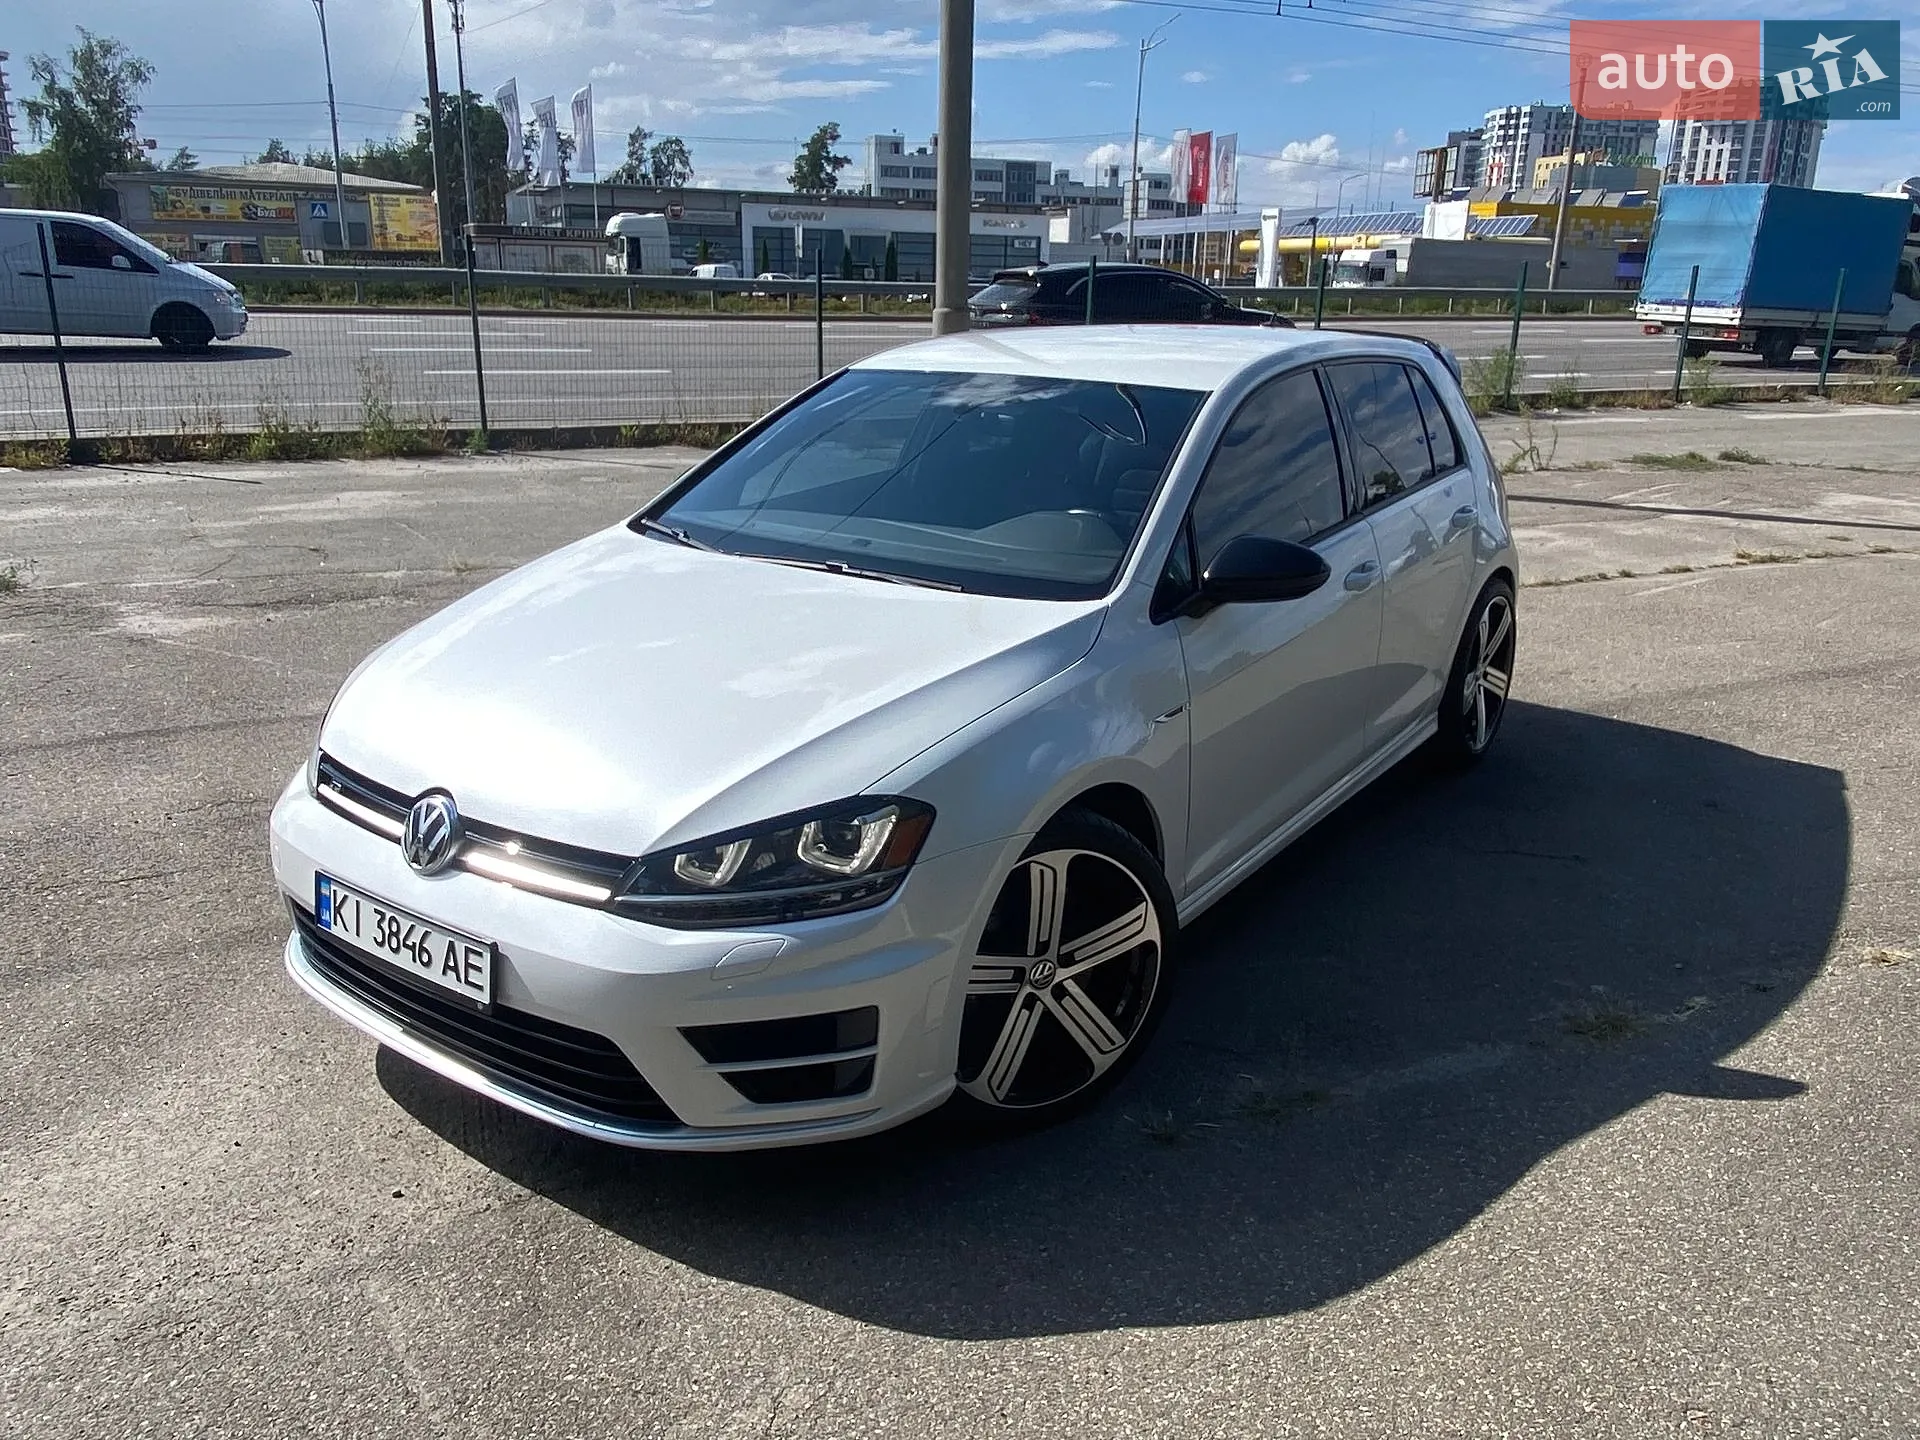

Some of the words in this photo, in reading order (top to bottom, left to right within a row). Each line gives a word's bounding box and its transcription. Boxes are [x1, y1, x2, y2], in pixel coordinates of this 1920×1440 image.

[512, 226, 562, 238] МАРКЕТ
[333, 889, 361, 938] KI
[373, 907, 433, 969] 3846
[442, 938, 485, 992] AE
